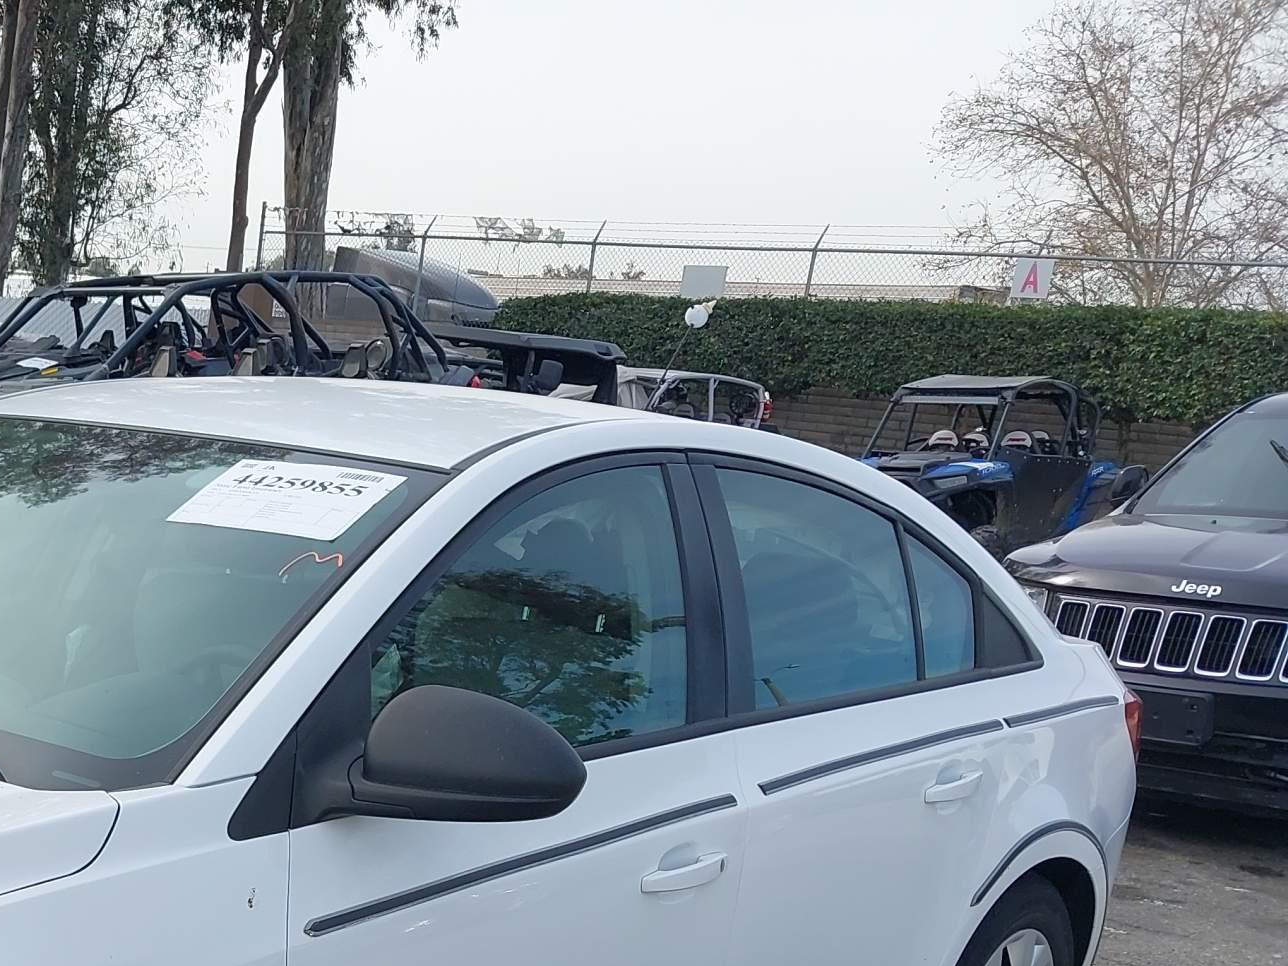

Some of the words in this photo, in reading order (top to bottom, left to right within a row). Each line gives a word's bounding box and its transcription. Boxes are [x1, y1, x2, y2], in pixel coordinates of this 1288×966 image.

[1020, 260, 1039, 294] A
[232, 473, 370, 497] 44259855
[1171, 579, 1222, 598] Jeep
